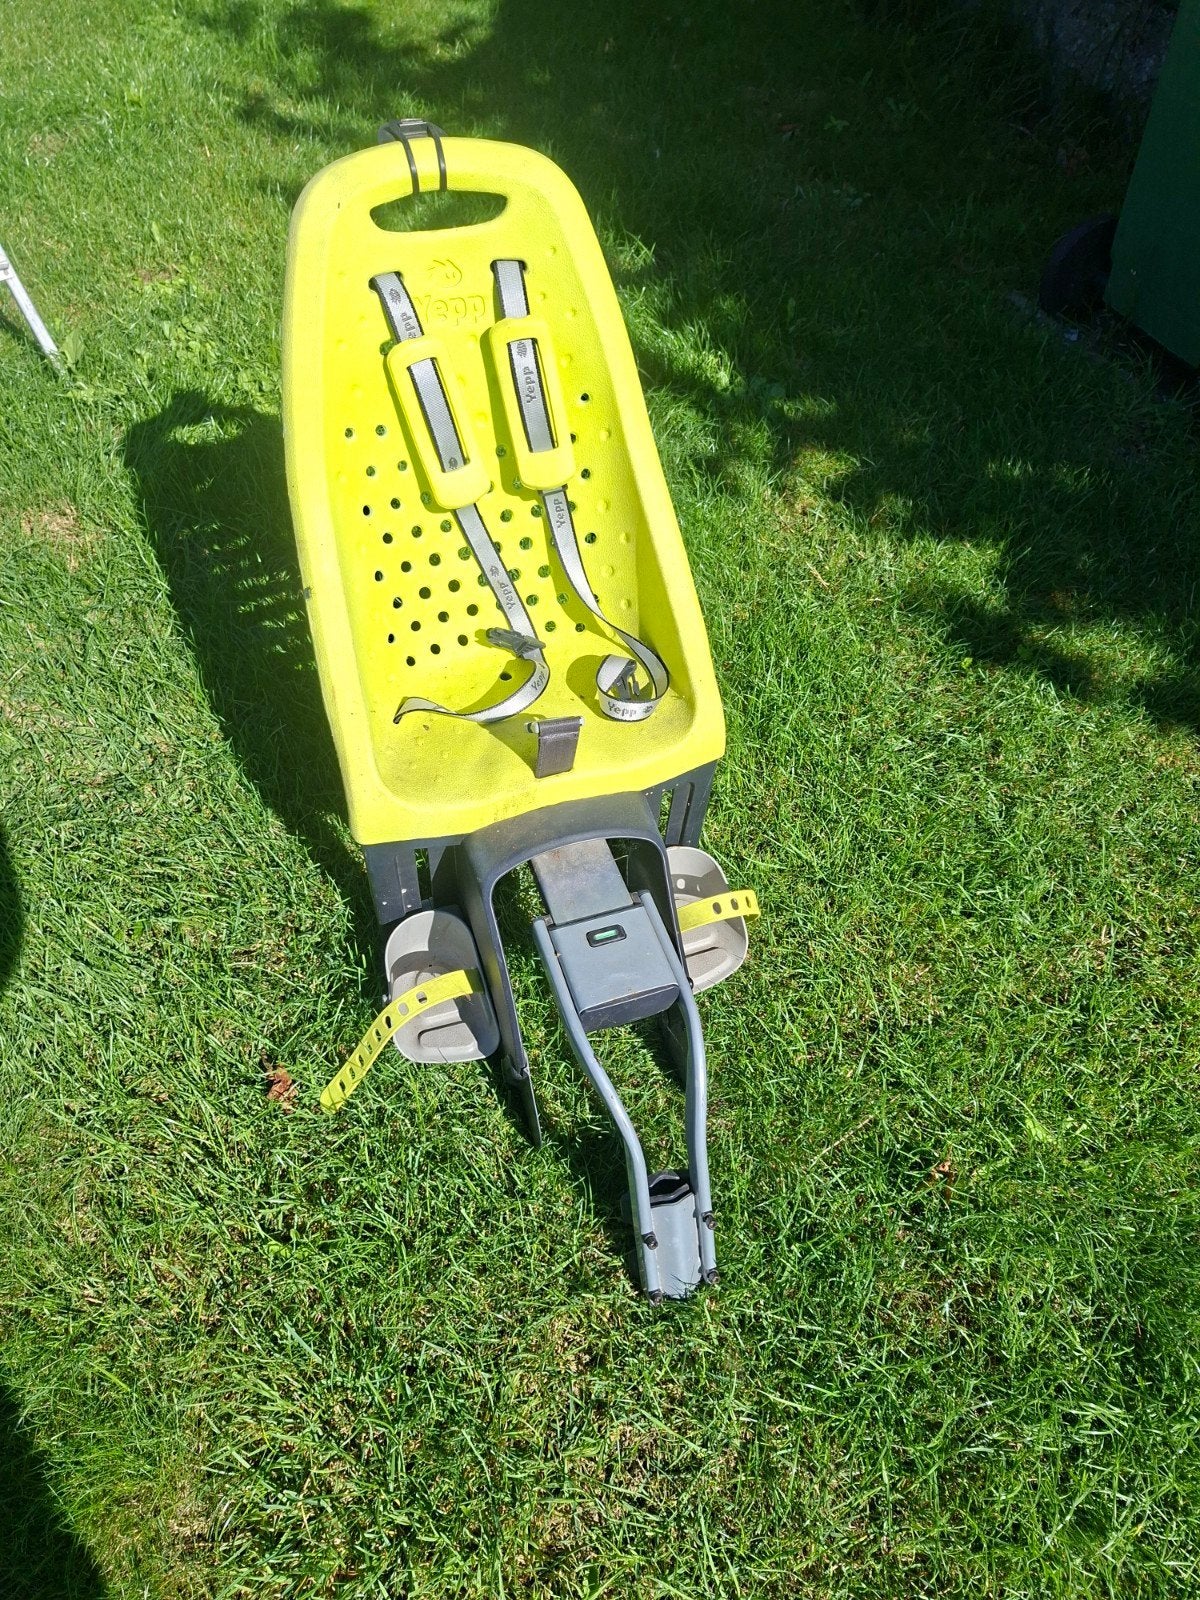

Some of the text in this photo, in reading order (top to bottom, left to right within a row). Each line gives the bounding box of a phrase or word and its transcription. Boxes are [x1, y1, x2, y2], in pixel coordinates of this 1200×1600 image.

[415, 295, 485, 326] Yepp
[401, 312, 417, 340] epp
[523, 366, 536, 403] Yepp
[553, 498, 566, 528] Yepp
[500, 583, 515, 609] Yepp
[531, 670, 547, 691] Yepp
[607, 701, 637, 716] Yepp
